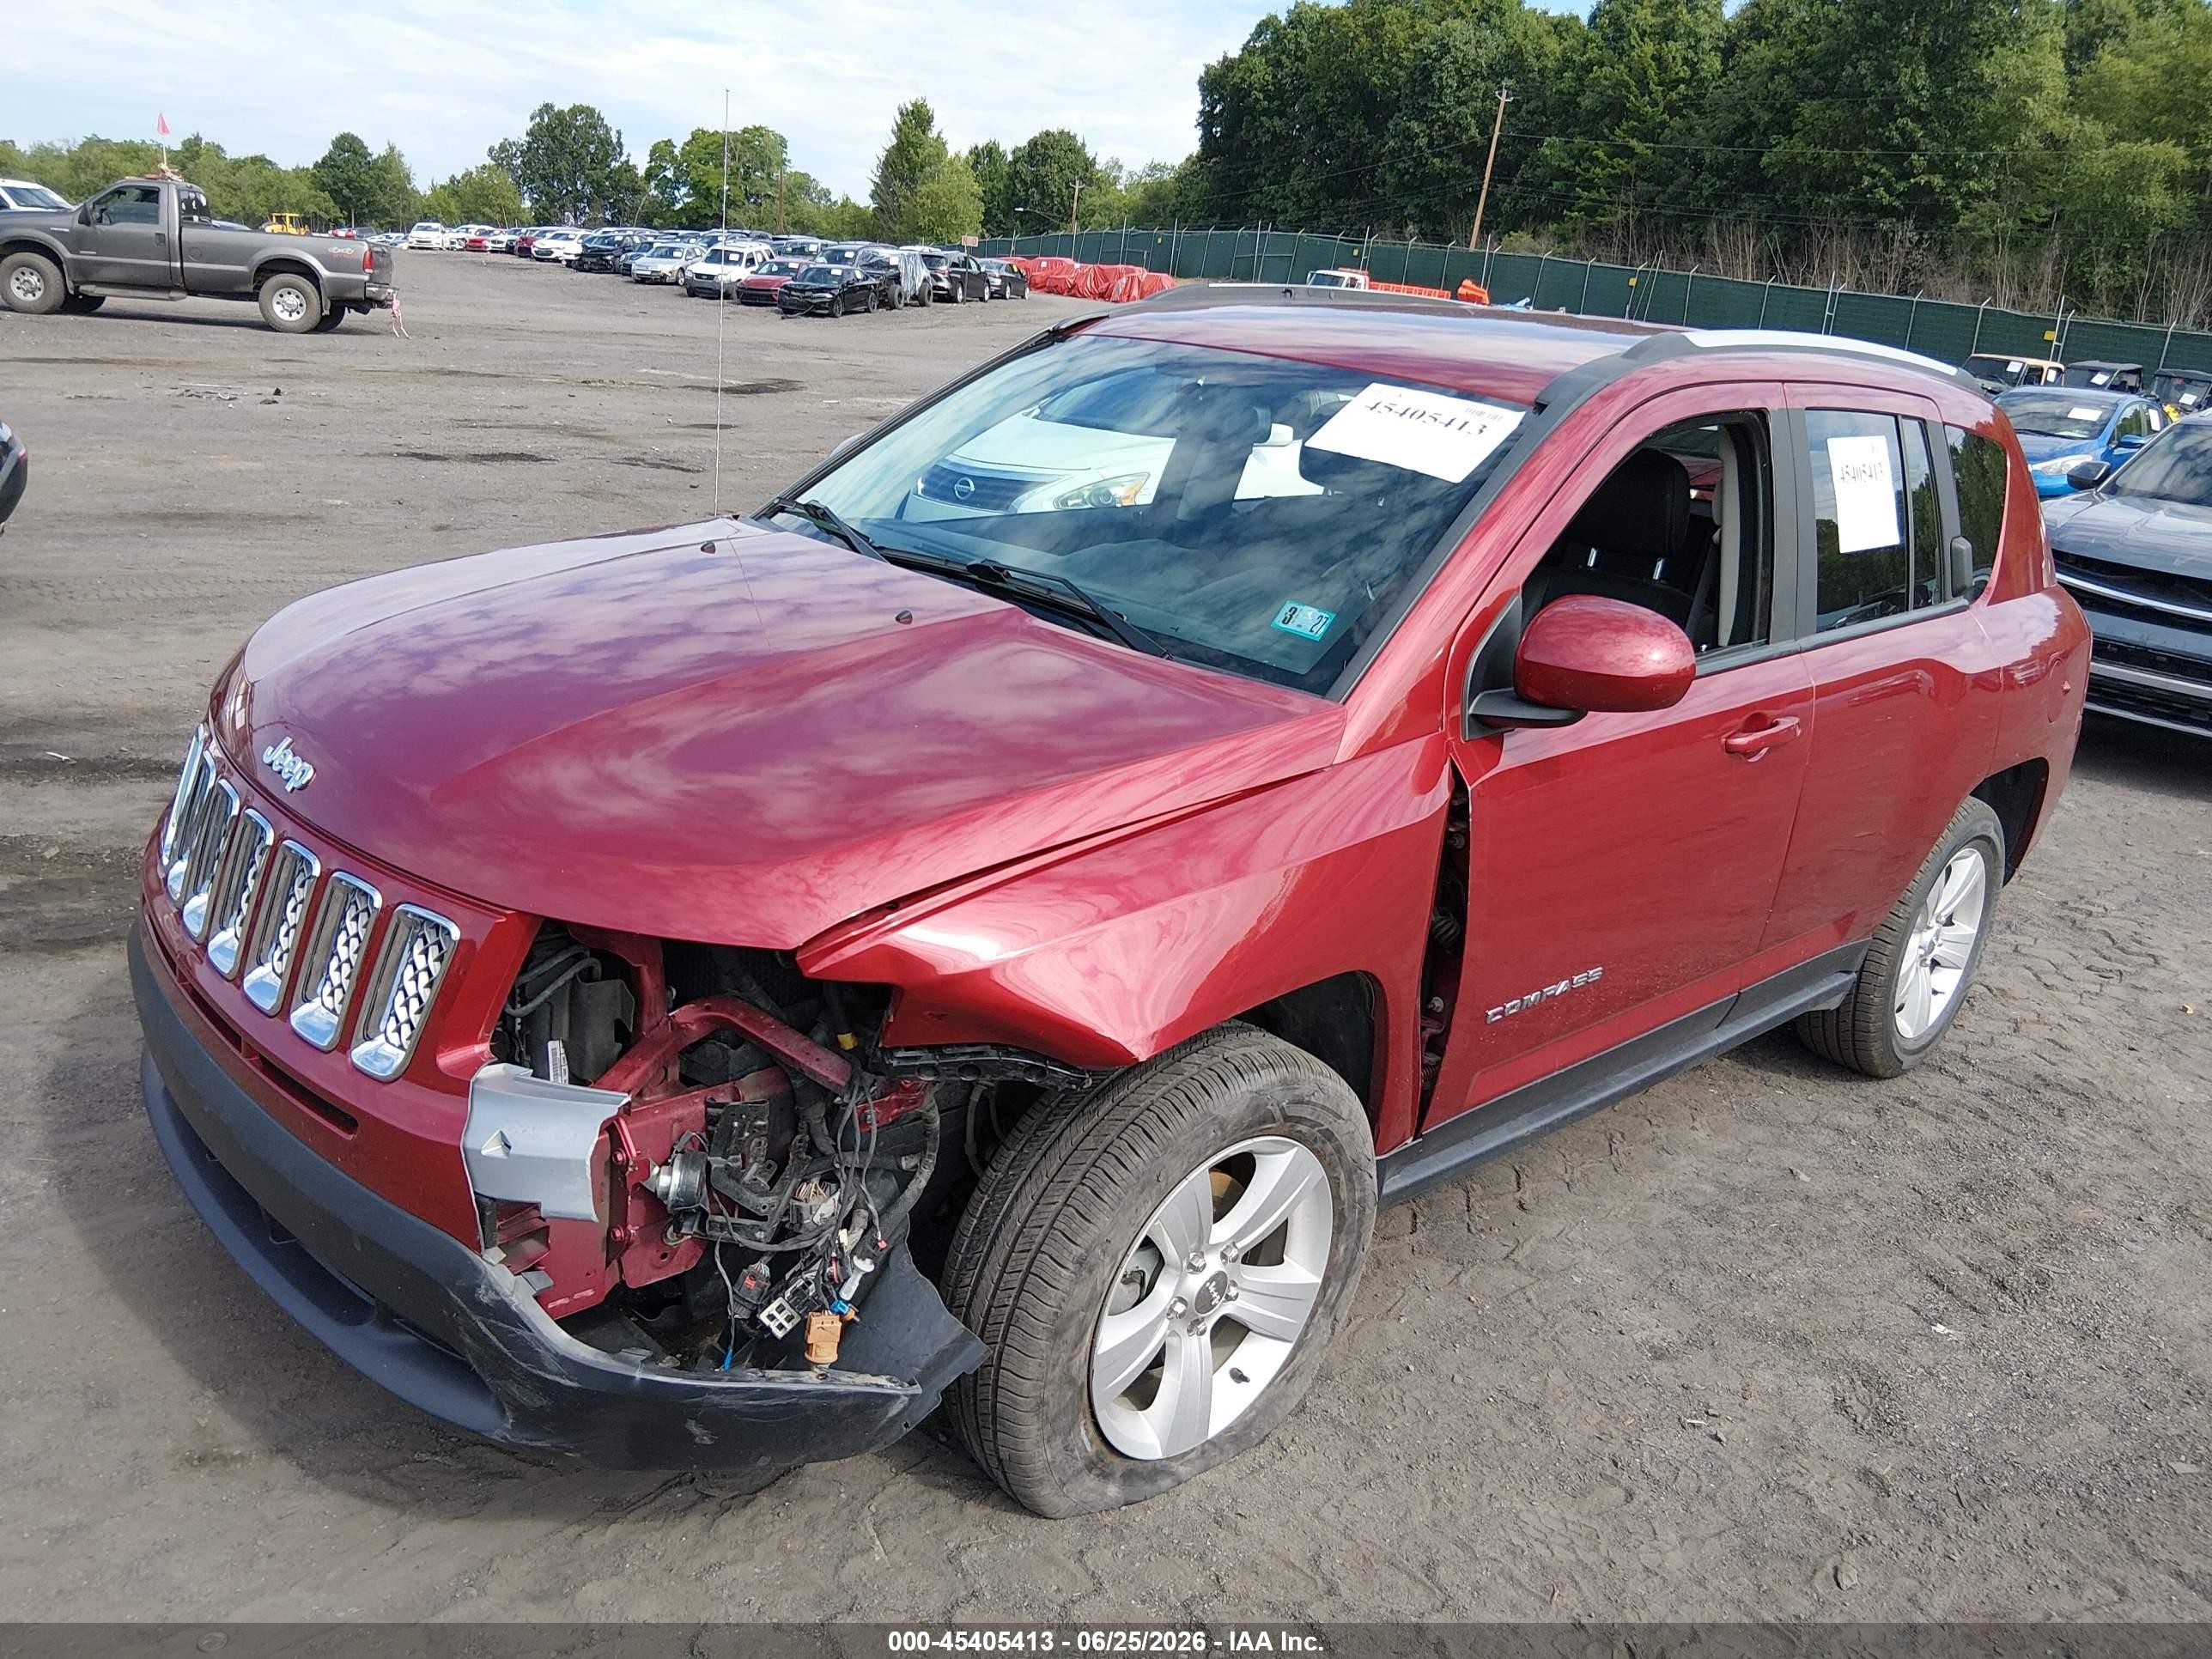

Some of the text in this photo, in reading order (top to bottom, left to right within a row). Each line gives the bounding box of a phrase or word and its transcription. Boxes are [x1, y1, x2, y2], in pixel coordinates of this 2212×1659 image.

[1365, 401, 1488, 435] 45405413
[1308, 615, 1329, 635] 27
[263, 736, 315, 793] Jeep
[1486, 966, 1604, 1024] COMPASS
